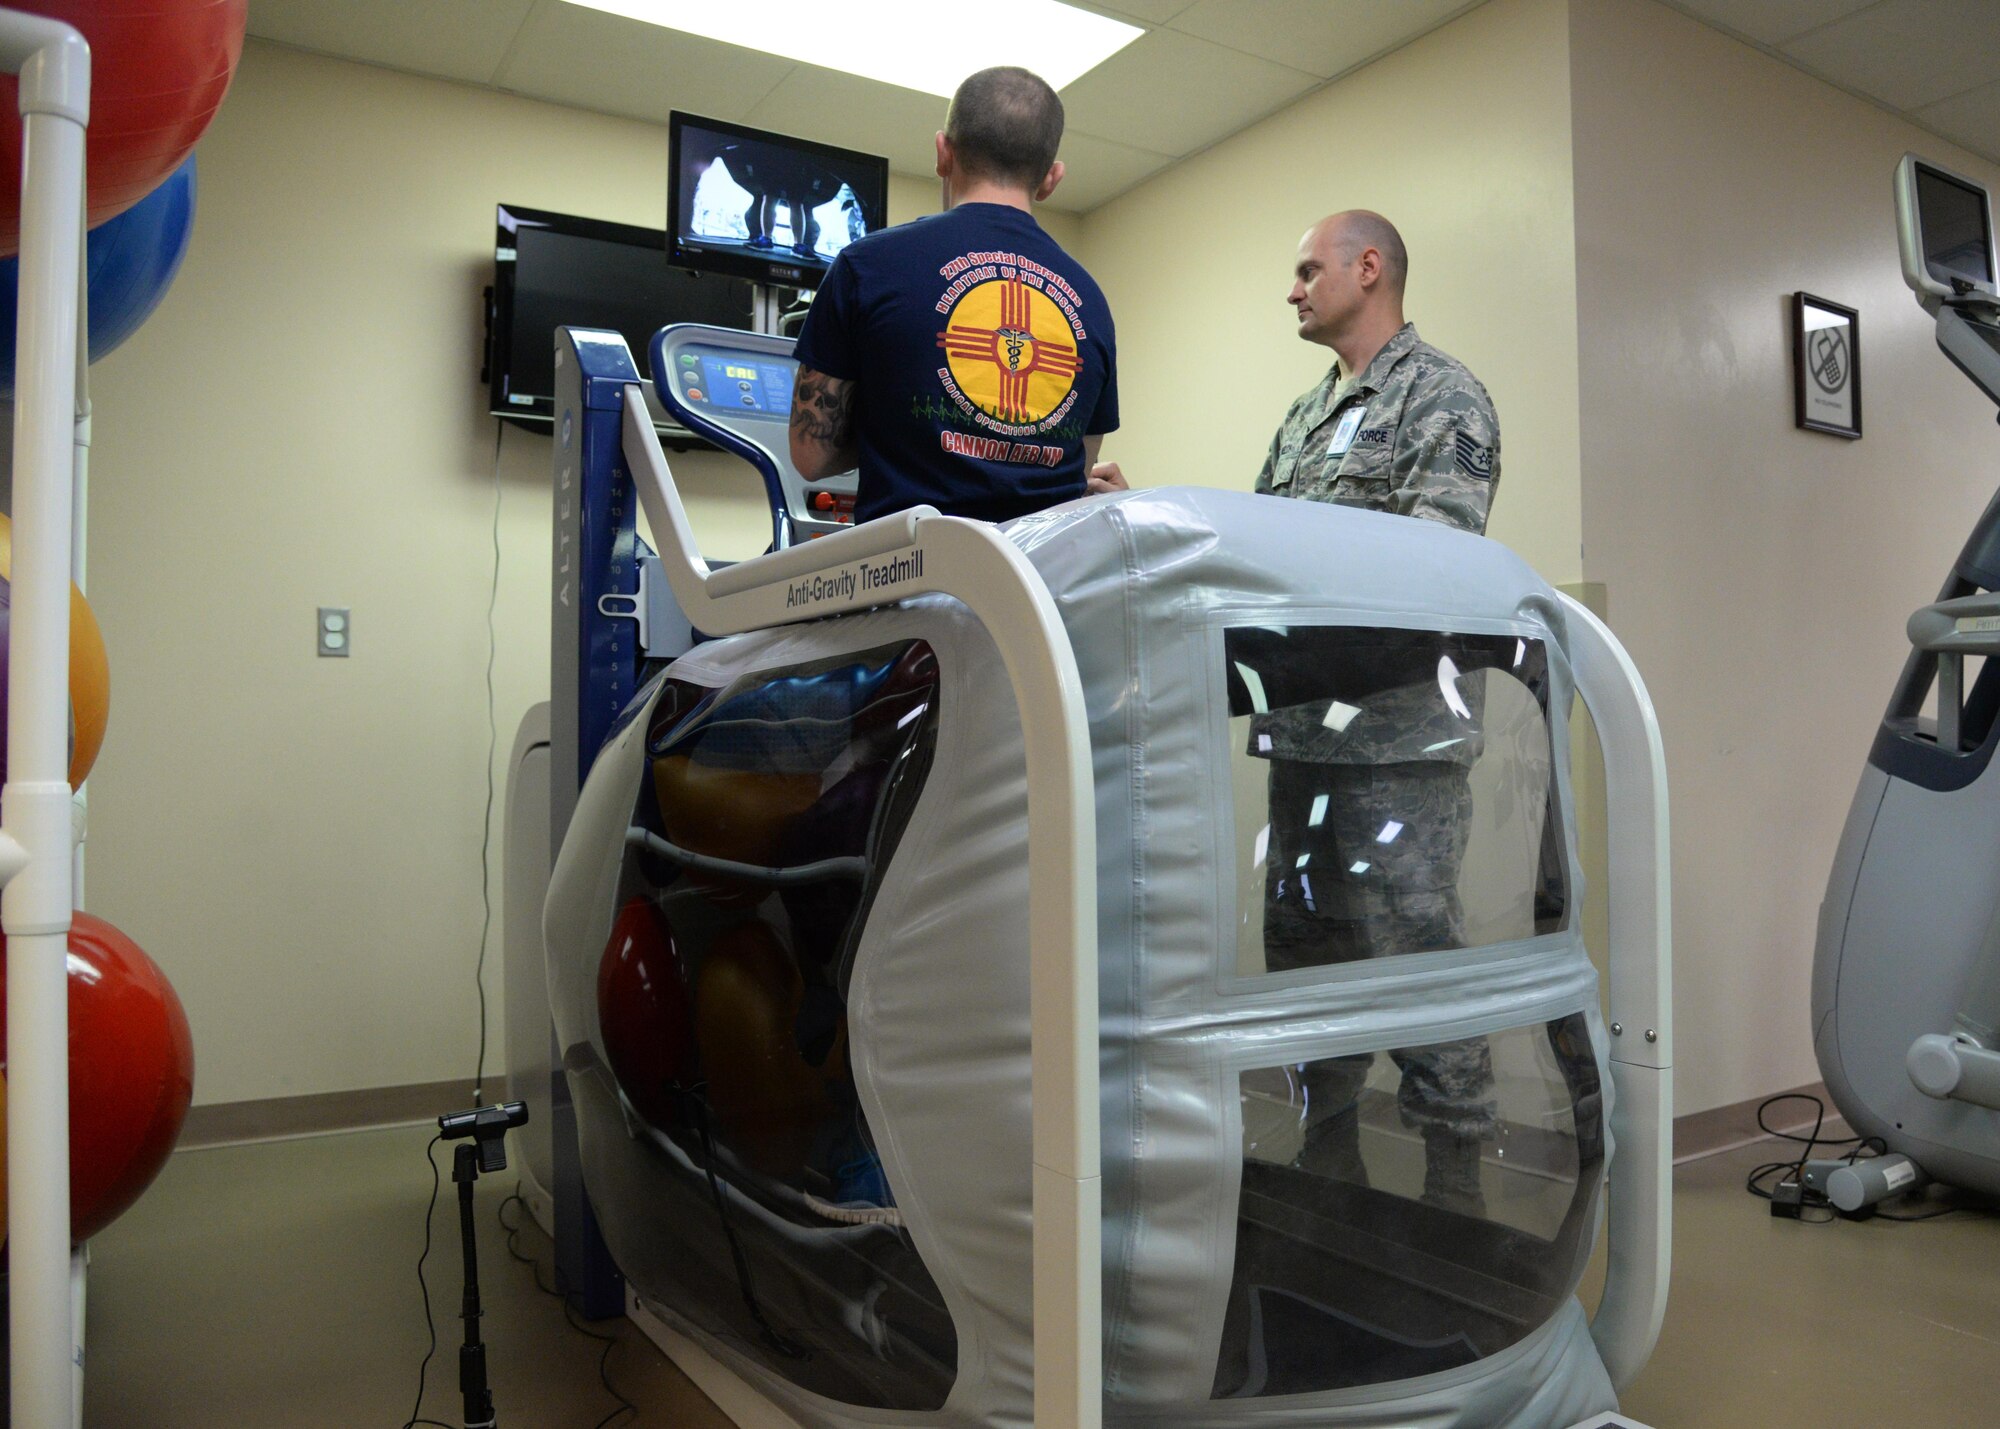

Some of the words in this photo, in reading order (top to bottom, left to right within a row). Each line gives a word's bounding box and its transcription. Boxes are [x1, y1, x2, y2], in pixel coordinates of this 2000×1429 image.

[939, 255, 971, 281] 27th
[967, 250, 1017, 266] Special
[1017, 255, 1083, 308] Operations
[935, 266, 998, 315] HEARTBEAT
[1000, 266, 1016, 279] OF
[1020, 270, 1044, 289] THE
[1045, 283, 1087, 341] MISSION
[725, 365, 759, 381] CAL
[936, 367, 975, 416] MEDICAL
[974, 412, 1037, 437] OPERATIONS
[1039, 389, 1079, 433] SQUADRON
[1357, 430, 1388, 444] FORCE
[940, 430, 1011, 462] CANNON
[1008, 443, 1041, 465] AFB
[1038, 445, 1064, 468] NM
[611, 565, 622, 575] 10
[786, 570, 856, 609] Anti-Gravity
[860, 549, 924, 592] Treadmill
[611, 623, 618, 633] 7
[611, 642, 618, 652] 6
[611, 662, 618, 672] 5
[610, 681, 618, 691] 4
[611, 700, 618, 711] 3
